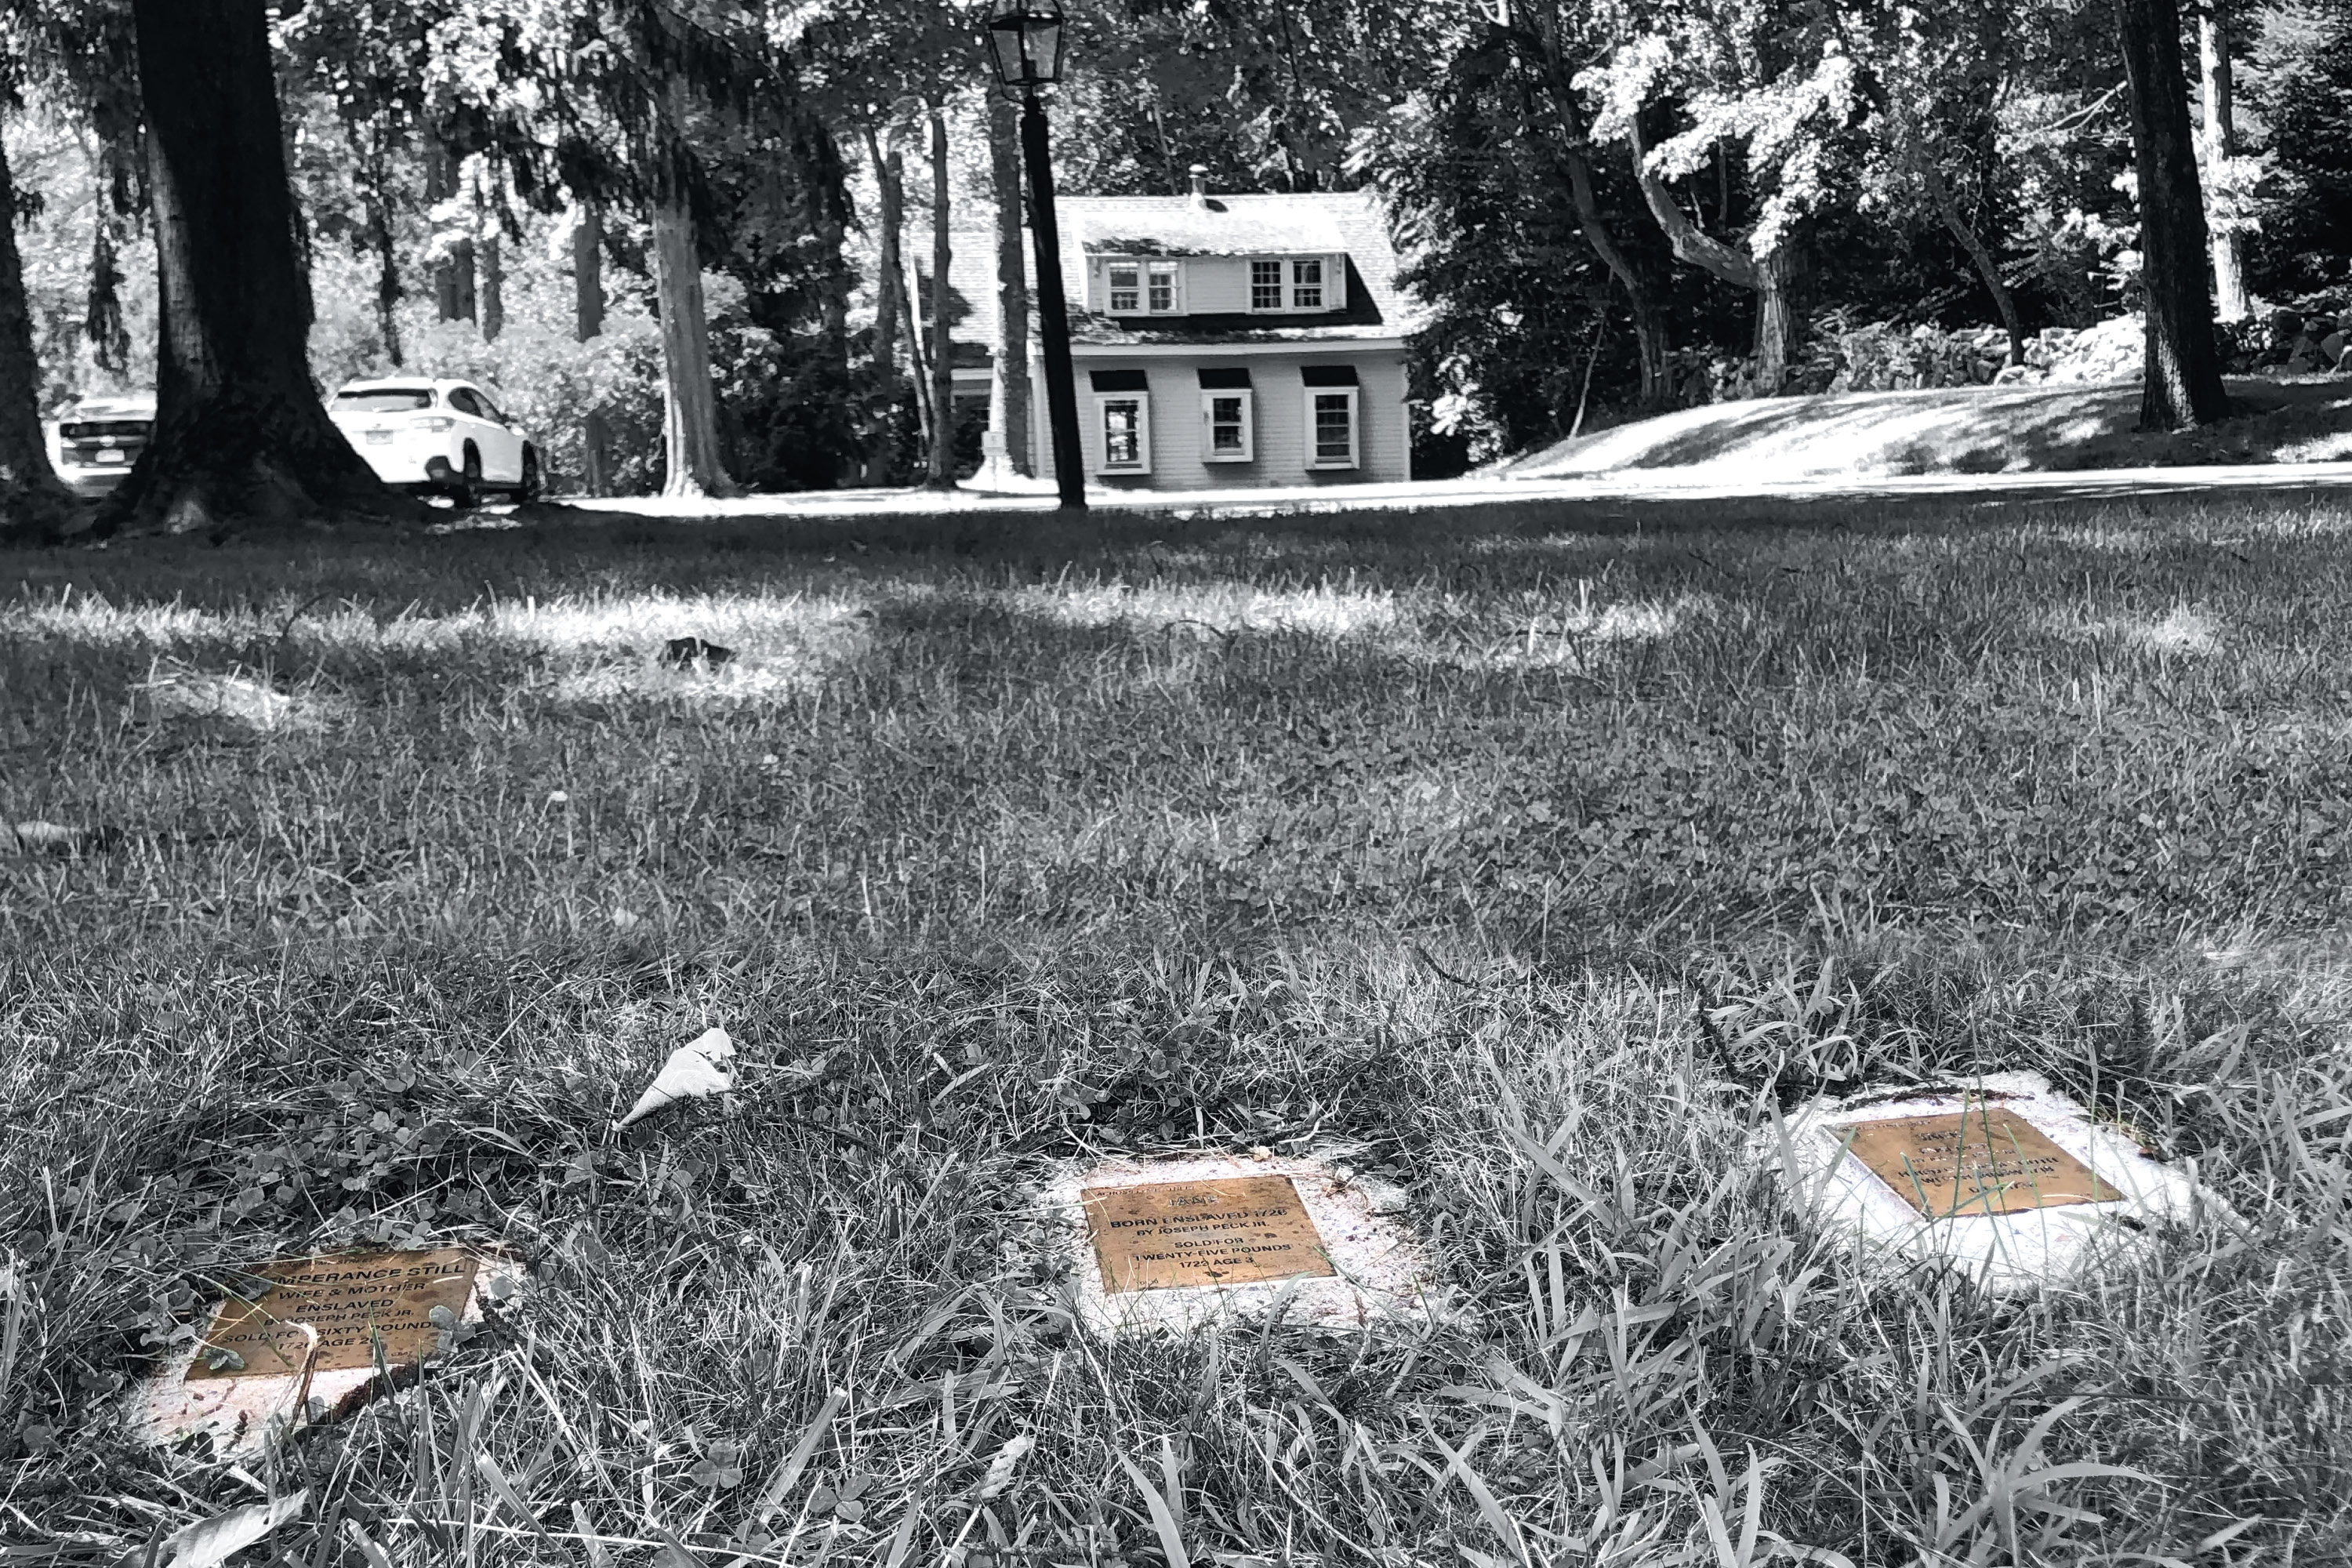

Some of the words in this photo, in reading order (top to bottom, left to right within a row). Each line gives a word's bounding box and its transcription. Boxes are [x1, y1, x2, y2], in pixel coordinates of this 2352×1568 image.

[1110, 1218, 1158, 1229] BORN
[1163, 1211, 1248, 1225] ENSLAVED
[1157, 1225, 1209, 1235] JOSEPH
[1212, 1221, 1250, 1230] PECK
[1174, 1240, 1212, 1248] SOLD
[1133, 1248, 1229, 1261] TWENTY-FIVE
[1232, 1243, 1292, 1254] POUNDS
[271, 1269, 401, 1284] MPERANCE
[408, 1265, 466, 1276] STILL
[279, 1290, 324, 1299] WIFE
[347, 1283, 426, 1295] MOTHER
[296, 1299, 394, 1313] ENSLAVED
[350, 1311, 390, 1319] PECK
[220, 1334, 270, 1343] SOLD
[316, 1325, 366, 1335] SIXTY
[375, 1321, 436, 1331] POUND
[320, 1338, 356, 1347] AGE
